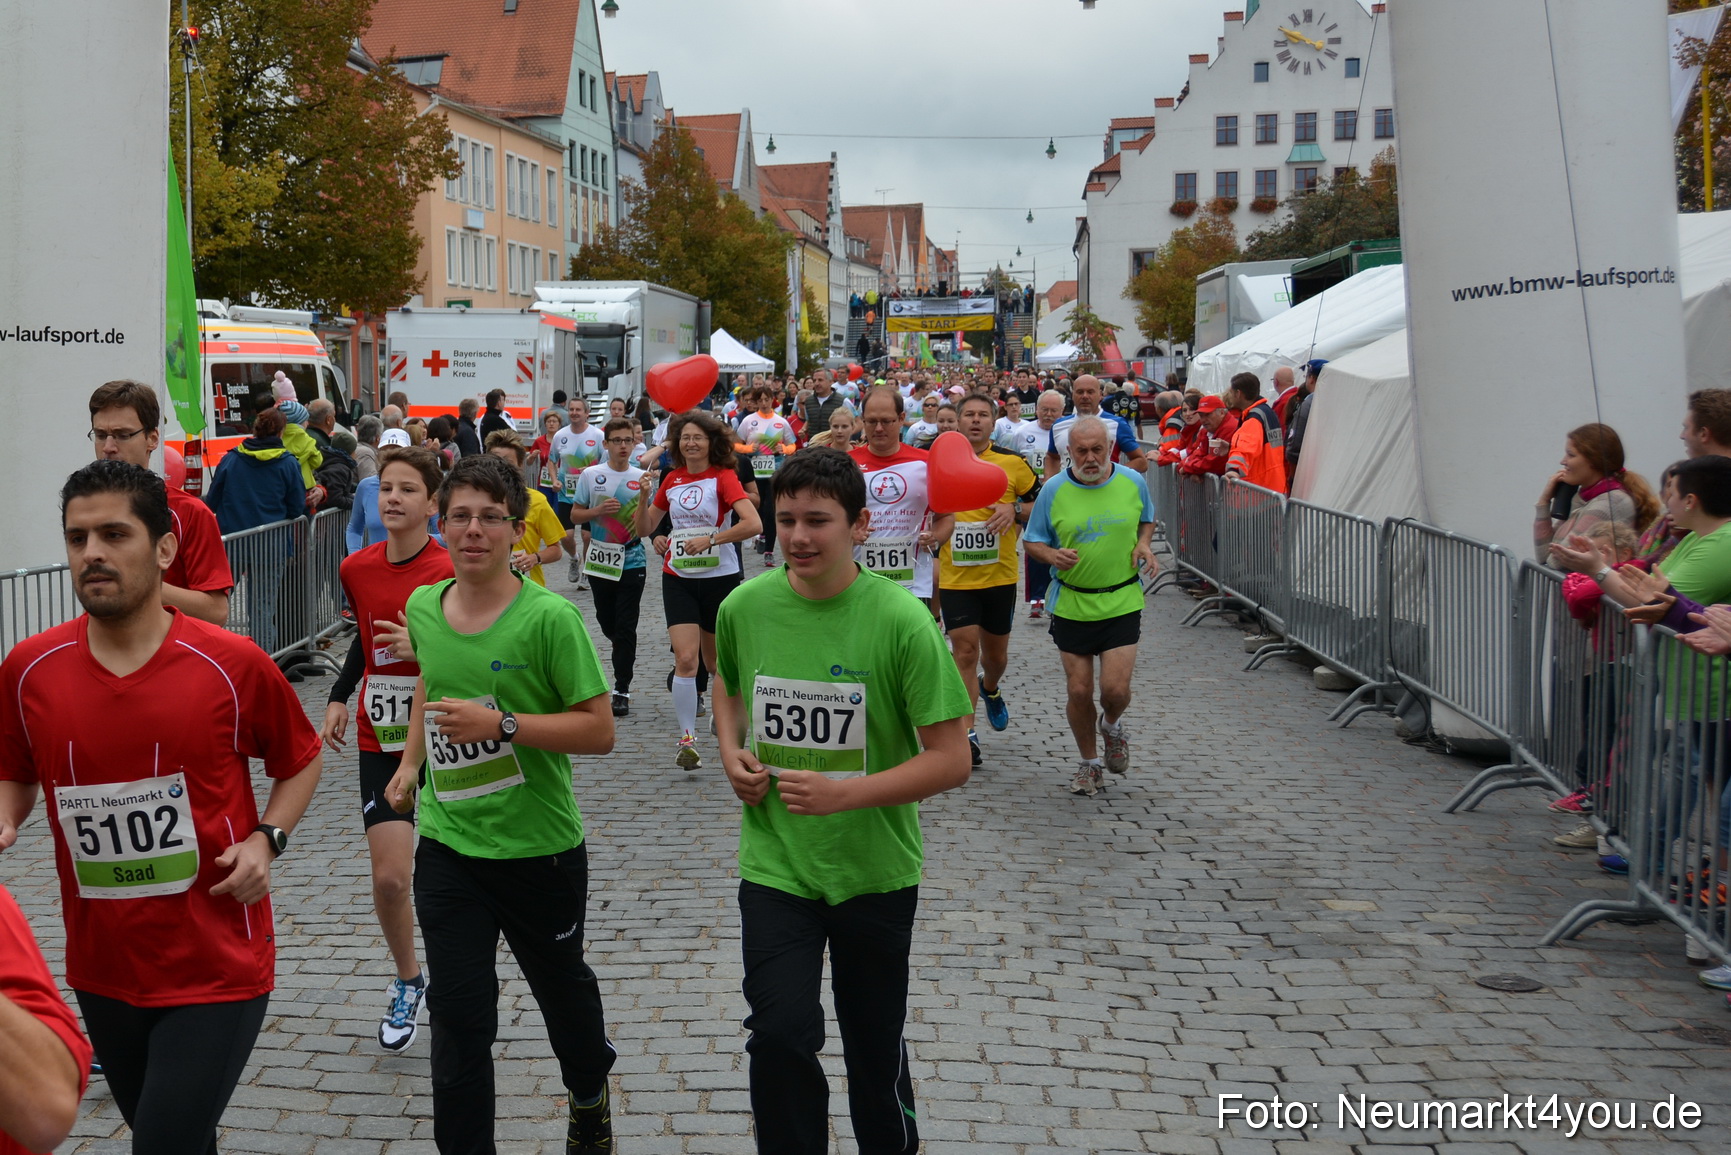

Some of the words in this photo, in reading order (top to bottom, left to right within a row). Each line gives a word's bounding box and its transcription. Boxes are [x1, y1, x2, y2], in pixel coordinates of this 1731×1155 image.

[1451, 265, 1675, 302] www.bmw-laufsport.de
[920, 319, 957, 329] START
[453, 350, 502, 359] Bayerisches
[453, 360, 476, 368] Rotes
[452, 370, 476, 378] Kreuz
[226, 383, 250, 396] Bayerisches
[228, 397, 240, 408] Rotes
[229, 410, 242, 421] Kreuz
[753, 460, 773, 469] 5072
[955, 532, 995, 549] 5099
[590, 548, 621, 567] 5012
[683, 559, 707, 567] Claudia
[866, 548, 907, 568] 5161
[368, 682, 388, 691] PARTL
[389, 683, 416, 692] Neuma
[755, 686, 790, 699] PARTL
[792, 690, 844, 703] Neumarkt
[370, 694, 413, 722] 511
[764, 703, 854, 744] 5307
[763, 745, 827, 769] Valentin
[443, 771, 489, 787] Alexander
[60, 798, 99, 810] PARTL
[101, 789, 164, 808] Neumarkt
[74, 804, 184, 856] 5102
[113, 864, 156, 883] Saad
